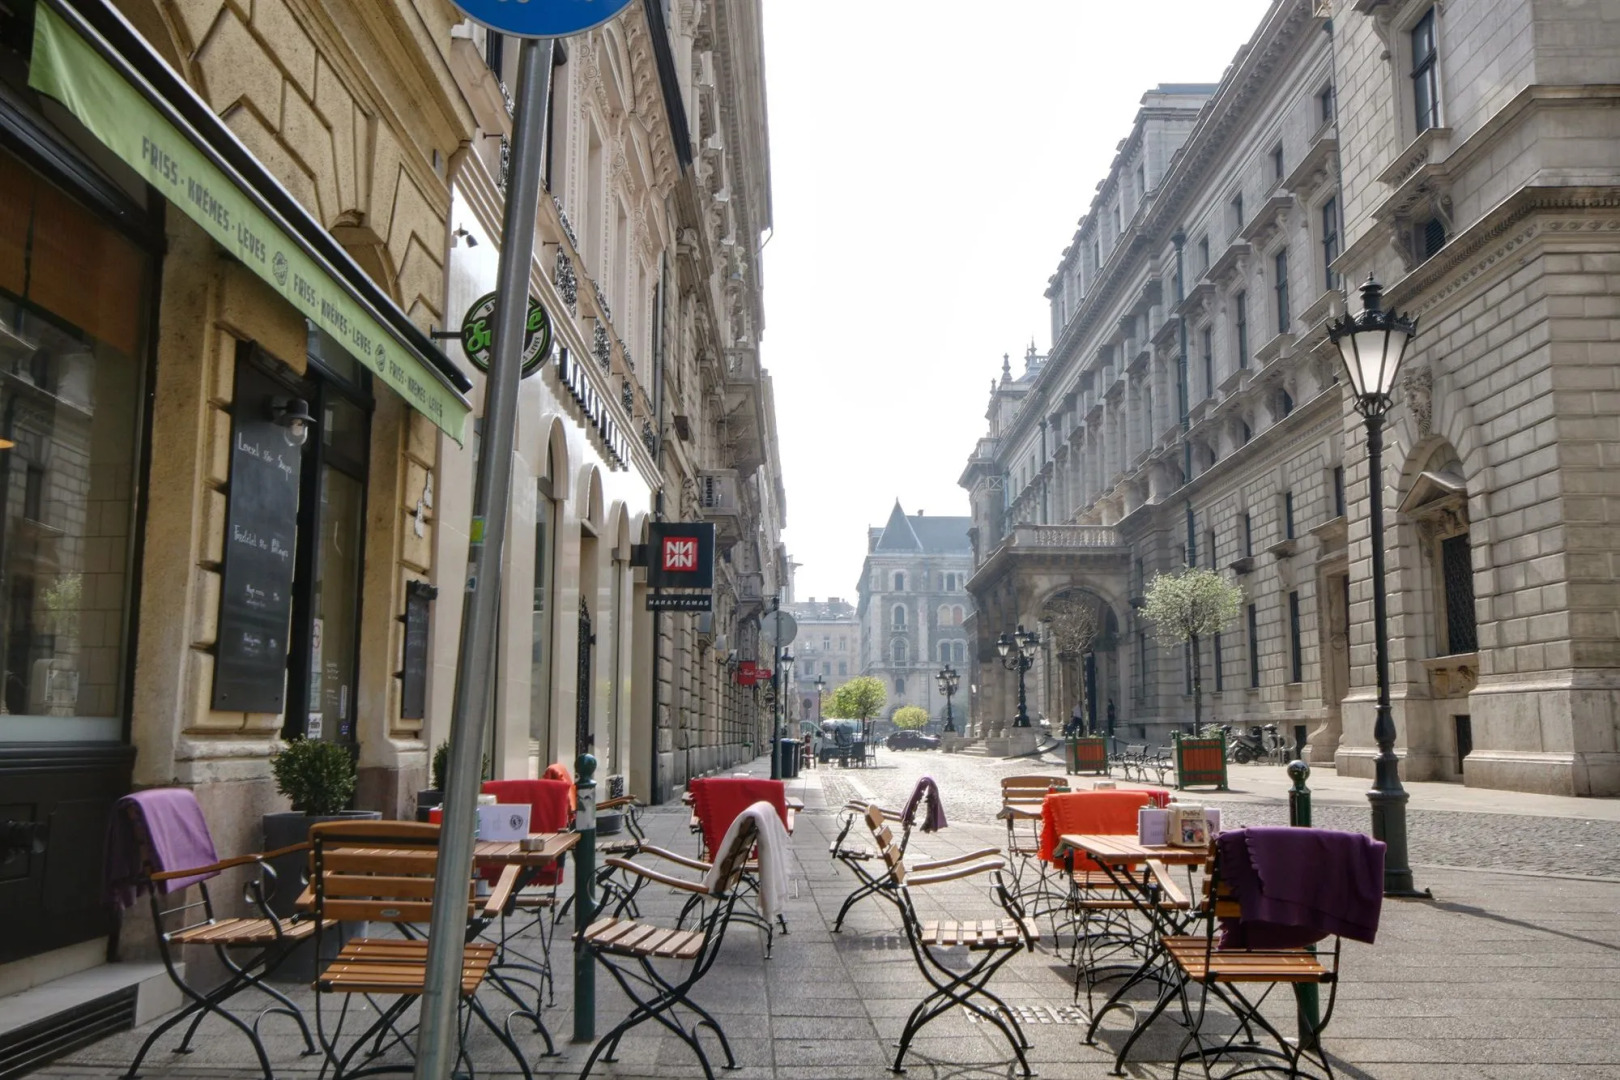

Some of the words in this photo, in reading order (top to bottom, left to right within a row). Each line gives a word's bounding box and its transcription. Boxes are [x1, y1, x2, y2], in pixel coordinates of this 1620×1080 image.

[142, 136, 178, 186] FRISS
[187, 176, 230, 232] KRÉMES
[237, 221, 266, 264] LEVES
[294, 272, 316, 308] FRISS
[352, 325, 372, 356] LEVES
